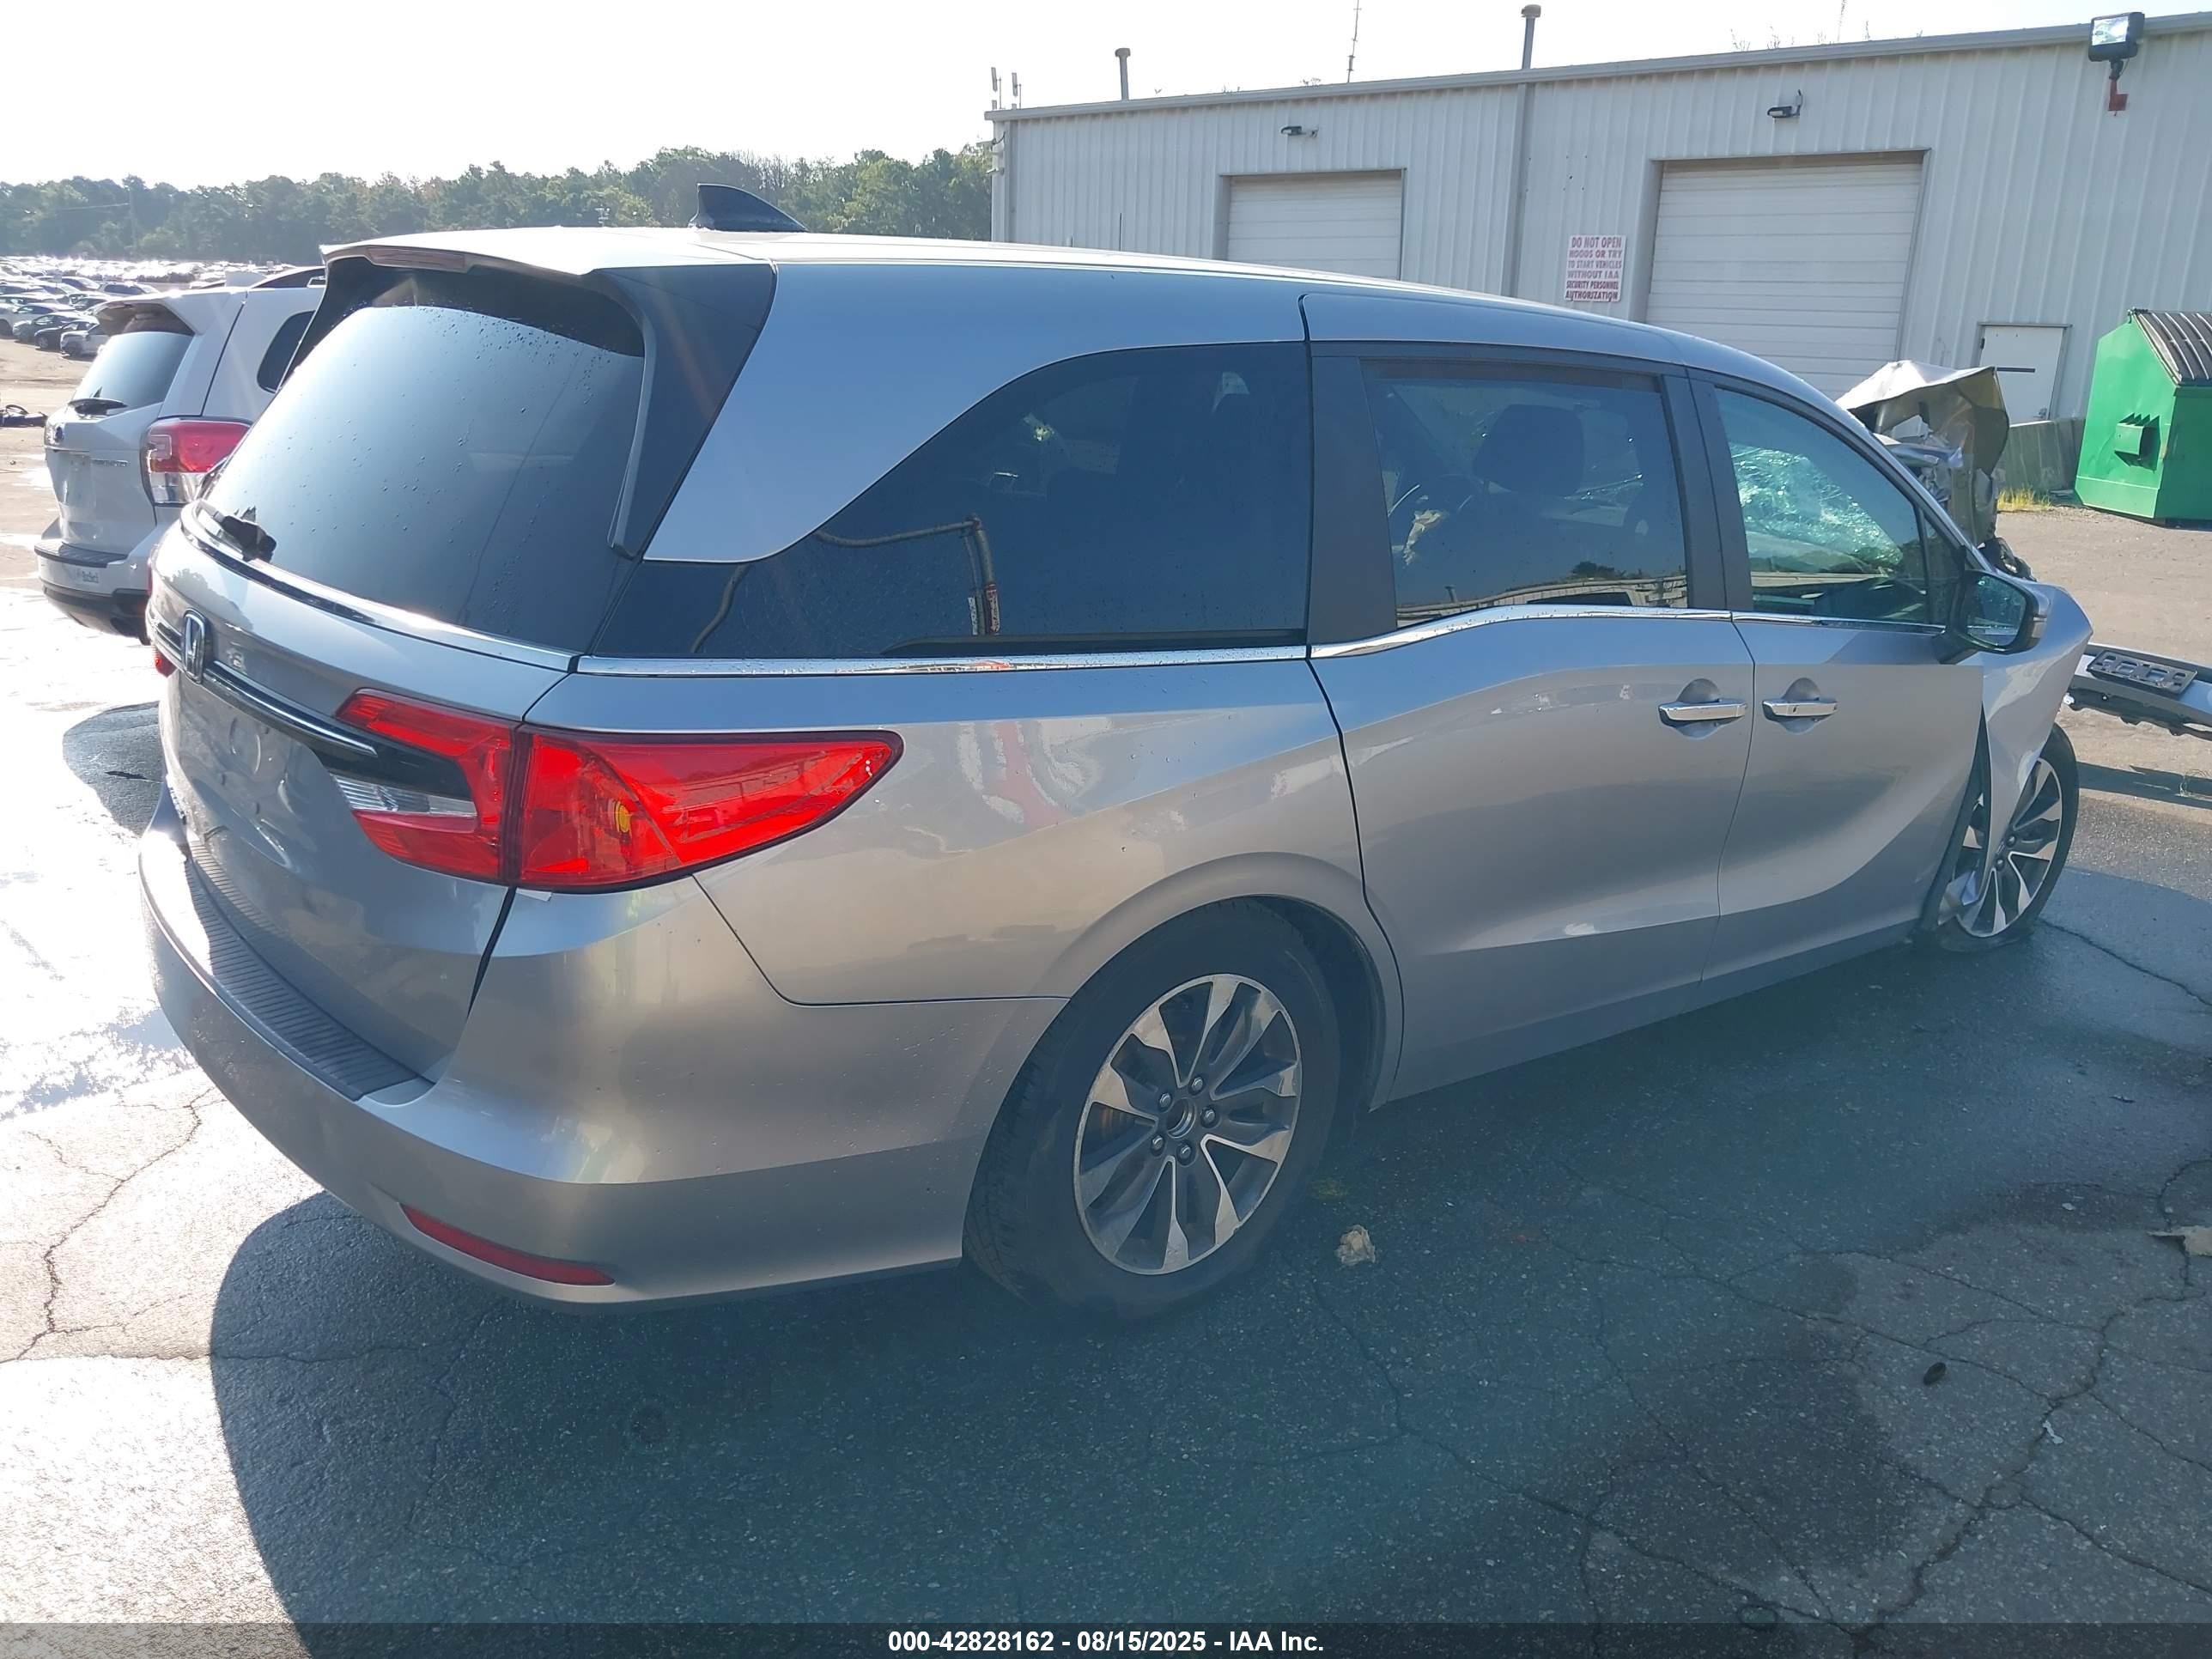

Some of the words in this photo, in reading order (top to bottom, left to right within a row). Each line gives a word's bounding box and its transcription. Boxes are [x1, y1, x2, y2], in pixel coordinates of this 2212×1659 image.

[1571, 237, 1582, 248] DO
[1583, 237, 1599, 248] NOT
[1601, 237, 1622, 248] OPEN
[1568, 260, 1575, 269] TO
[1577, 260, 1594, 269] START
[1595, 260, 1621, 269] VEHICLES
[1567, 270, 1602, 279] WITHOUT
[1604, 270, 1620, 279] IAA
[1566, 281, 1589, 289] SECURITY
[1590, 281, 1619, 289] PERSONNEL
[1565, 290, 1619, 300] AUTHORIZATION
